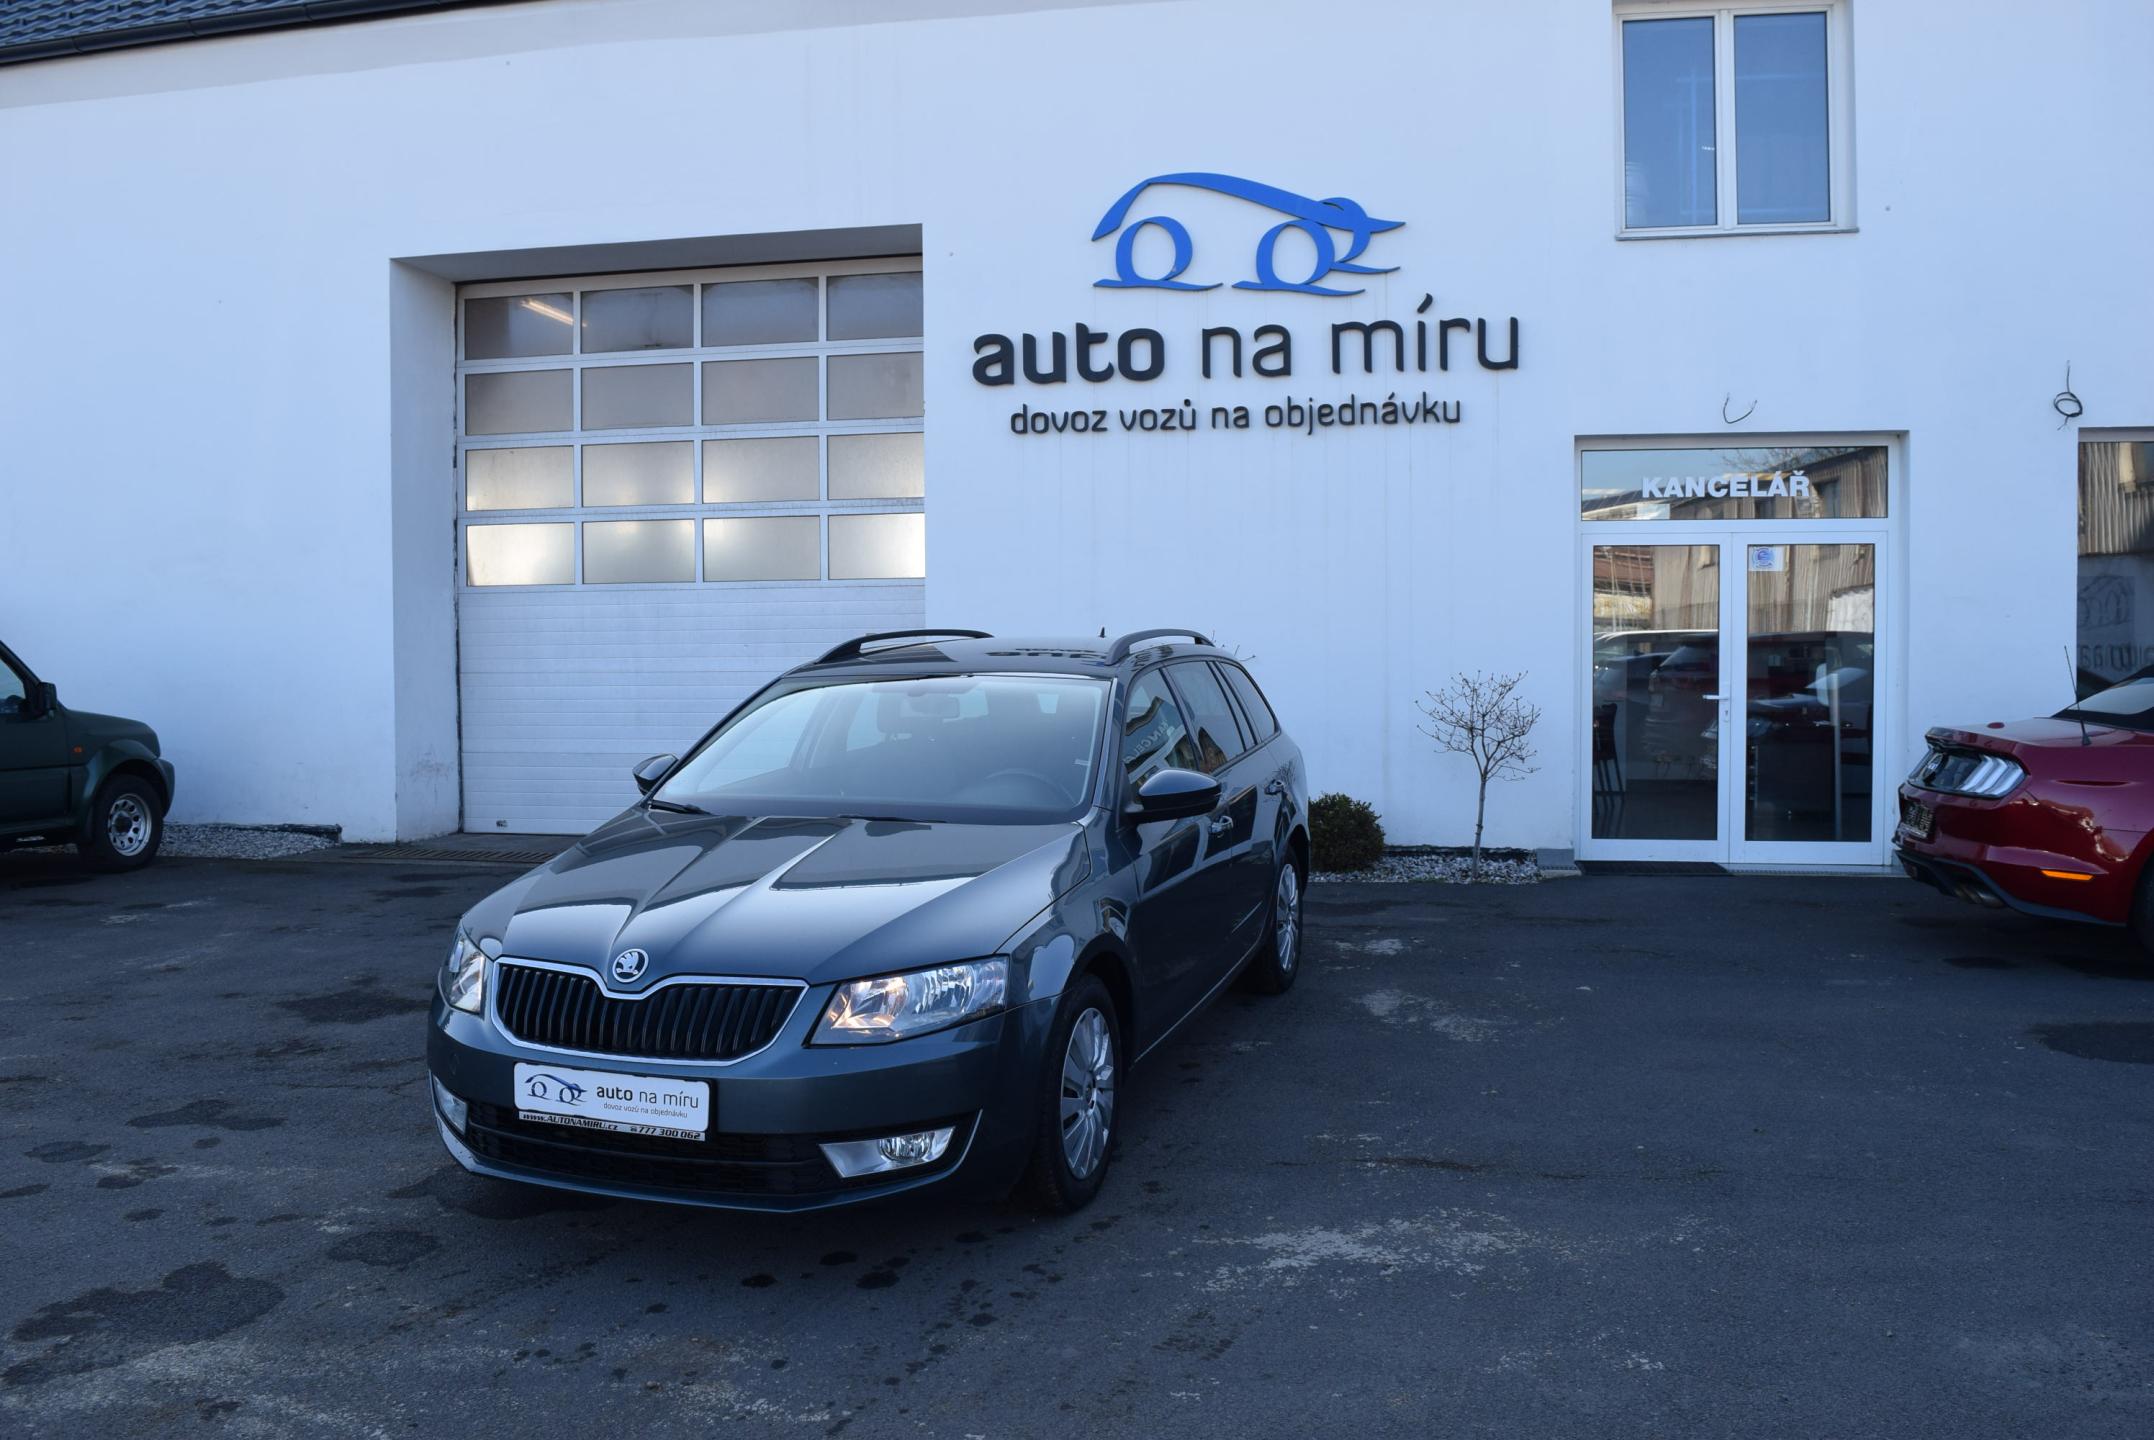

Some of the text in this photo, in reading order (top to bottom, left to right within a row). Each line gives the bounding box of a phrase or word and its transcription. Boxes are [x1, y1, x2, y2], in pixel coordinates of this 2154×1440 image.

[972, 292, 1520, 387] auto na míru
[1010, 391, 1461, 436] dovoz vozů na objednávku
[1641, 470, 1811, 498] KANCELÁŘ
[596, 1086, 699, 1109] auto na míru
[603, 1102, 623, 1111] dovoz
[623, 1105, 640, 1113] vozů
[650, 1107, 688, 1119] objednávku
[639, 1126, 656, 1135] 777
[659, 1129, 679, 1138] 300
[680, 1131, 701, 1140] 062
